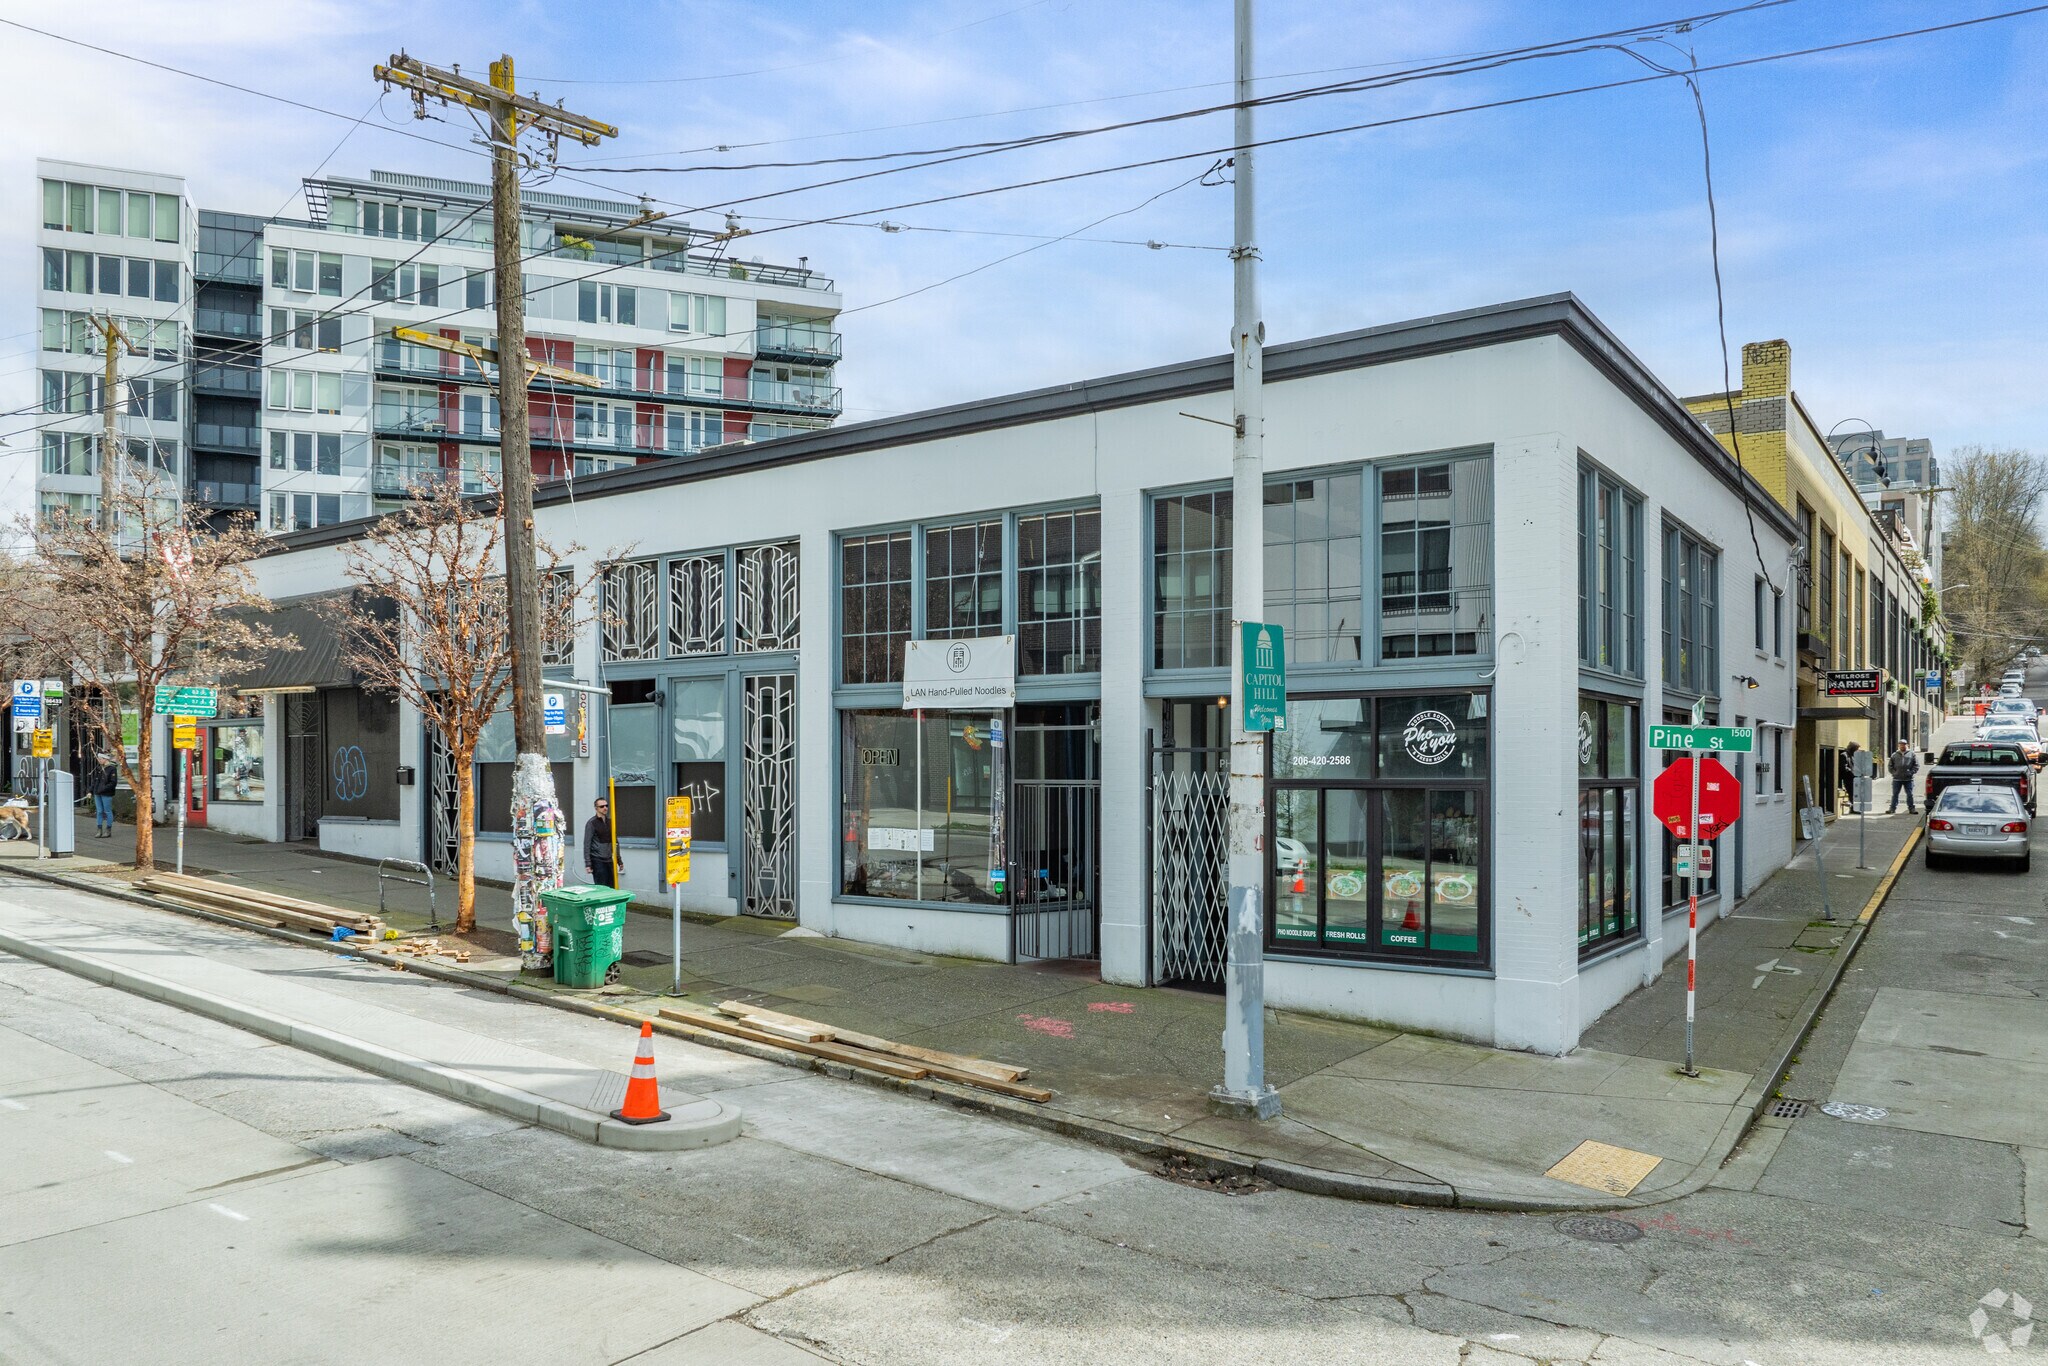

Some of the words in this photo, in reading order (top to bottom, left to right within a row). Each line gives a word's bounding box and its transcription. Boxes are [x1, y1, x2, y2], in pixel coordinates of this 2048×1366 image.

[1246, 673, 1284, 687] CAPITOL
[1828, 680, 1876, 689] MARKET
[910, 688, 926, 697] LAN
[928, 686, 973, 697] Hand-Pulled
[975, 685, 1007, 696] Noodles
[1254, 688, 1278, 700] HILL
[1254, 703, 1278, 713] Welcomes
[1410, 712, 1431, 727] NOODLE
[1432, 713, 1450, 726] SOUPS
[1402, 726, 1434, 747] Pho
[1653, 729, 1694, 748] Pine
[1709, 737, 1724, 749] St
[1731, 729, 1751, 738] 1500
[1420, 740, 1428, 753] 4
[1429, 733, 1457, 753] you
[863, 749, 897, 764] OPEN
[1293, 756, 1351, 766] 206-420-2586
[1433, 750, 1449, 762] ROLLS
[1277, 928, 1286, 936] PHO
[1286, 929, 1302, 937] NOODLE
[1302, 930, 1317, 938] SOUPS
[1325, 930, 1346, 939] FRESH
[1346, 932, 1366, 940] ROLLS
[1390, 934, 1417, 944] COFFEE
